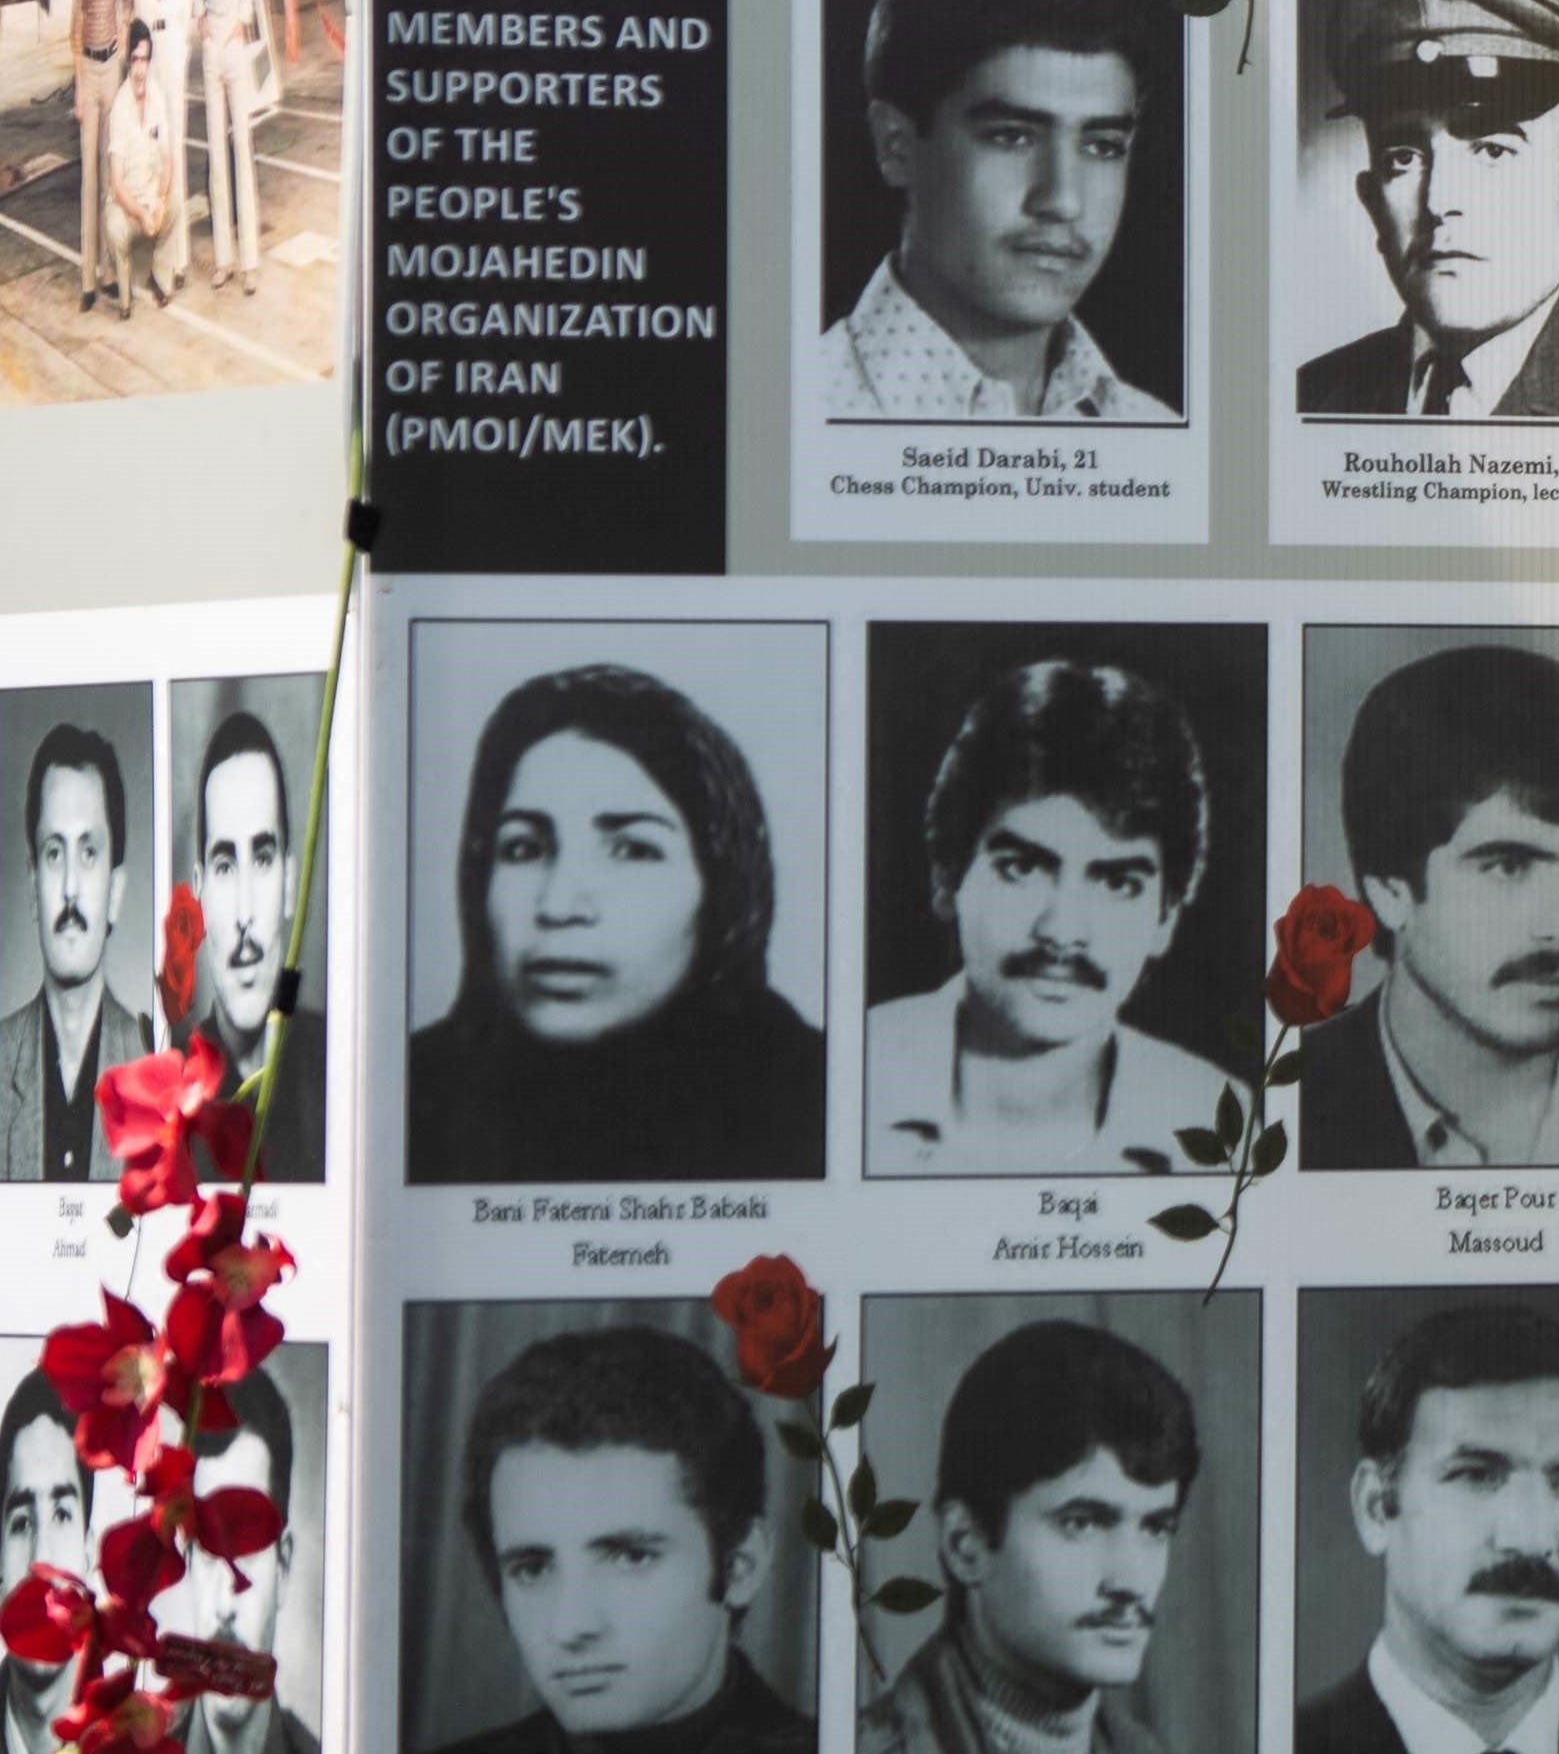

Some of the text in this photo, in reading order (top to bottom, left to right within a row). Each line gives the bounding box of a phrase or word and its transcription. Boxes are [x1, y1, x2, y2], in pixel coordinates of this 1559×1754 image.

[389, 12, 709, 49] MEMBERS AND
[387, 70, 662, 107] SUPPORTERS
[387, 127, 534, 162] OF THE
[389, 186, 580, 221] PEOPLE'S
[389, 245, 645, 280] MOJAHEDIN
[387, 302, 714, 338] ORGANIZATION
[386, 360, 560, 393] OF IRAN
[387, 414, 662, 458] (PMOI/MEK).
[903, 447, 1097, 471] Saeid Darabi, 21
[1344, 452, 1461, 473] Rouhollah
[1469, 454, 1559, 478] Nazemi,
[831, 475, 1170, 499] Chess Champion, Univ. student
[1322, 481, 1417, 502] Wrestling
[1424, 481, 1527, 503] Champion,
[474, 1196, 767, 1222] Bani Fatemi Shahr Babaki
[1039, 1192, 1098, 1221] Baqai
[1437, 1186, 1556, 1216] Baqer Pour
[53, 1240, 86, 1257] Ahmad
[574, 1242, 669, 1265] Fatemeh
[993, 1235, 1143, 1260] Amir Hossein
[1449, 1230, 1543, 1253] Massoud
